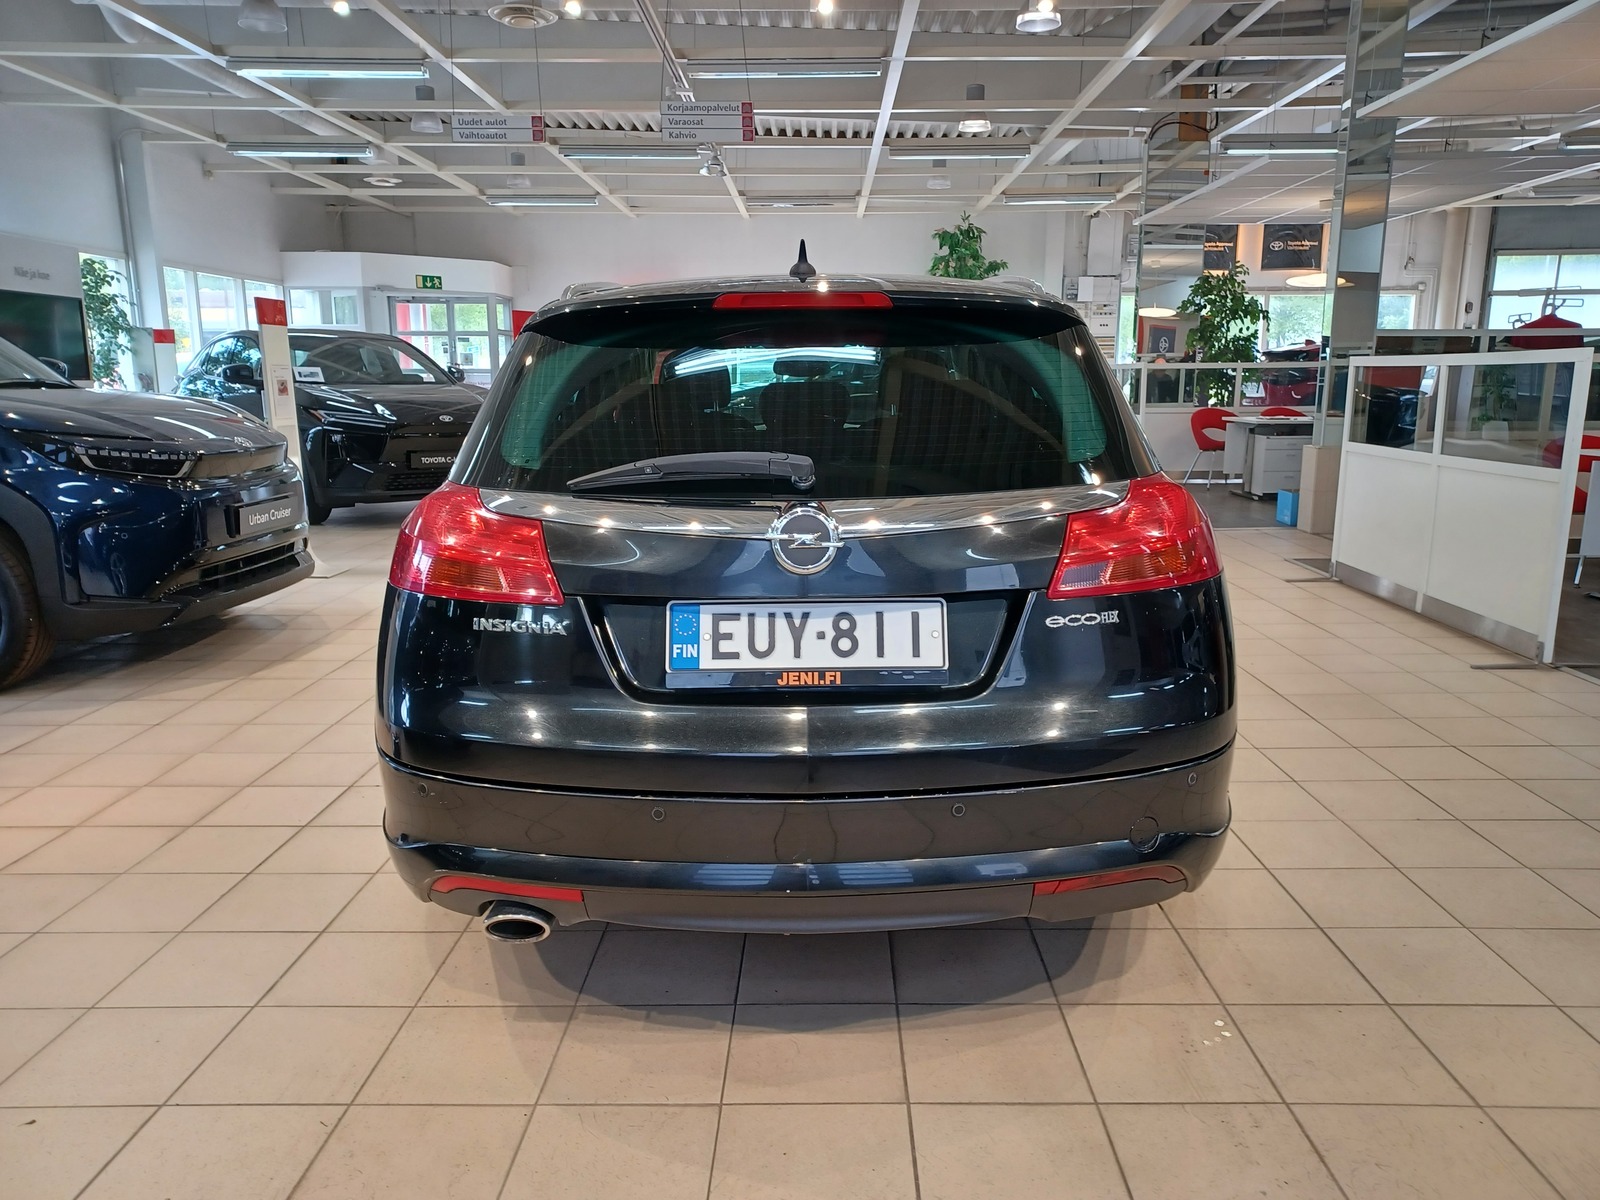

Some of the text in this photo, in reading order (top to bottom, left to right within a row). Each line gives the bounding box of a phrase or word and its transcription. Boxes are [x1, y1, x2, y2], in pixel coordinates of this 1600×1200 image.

[667, 103, 740, 113] Korjaamopalvelut
[458, 118, 483, 126] Uudet
[668, 117, 704, 126] Varaosat
[459, 131, 508, 139] Vaihtoautot
[668, 131, 697, 139] Kahvio
[249, 507, 292, 526] Urban Cruiser
[472, 617, 568, 636] INSIGNIA
[711, 611, 921, 660] EUY-811
[673, 643, 698, 658] FIN
[777, 671, 841, 685] JENI.FI
